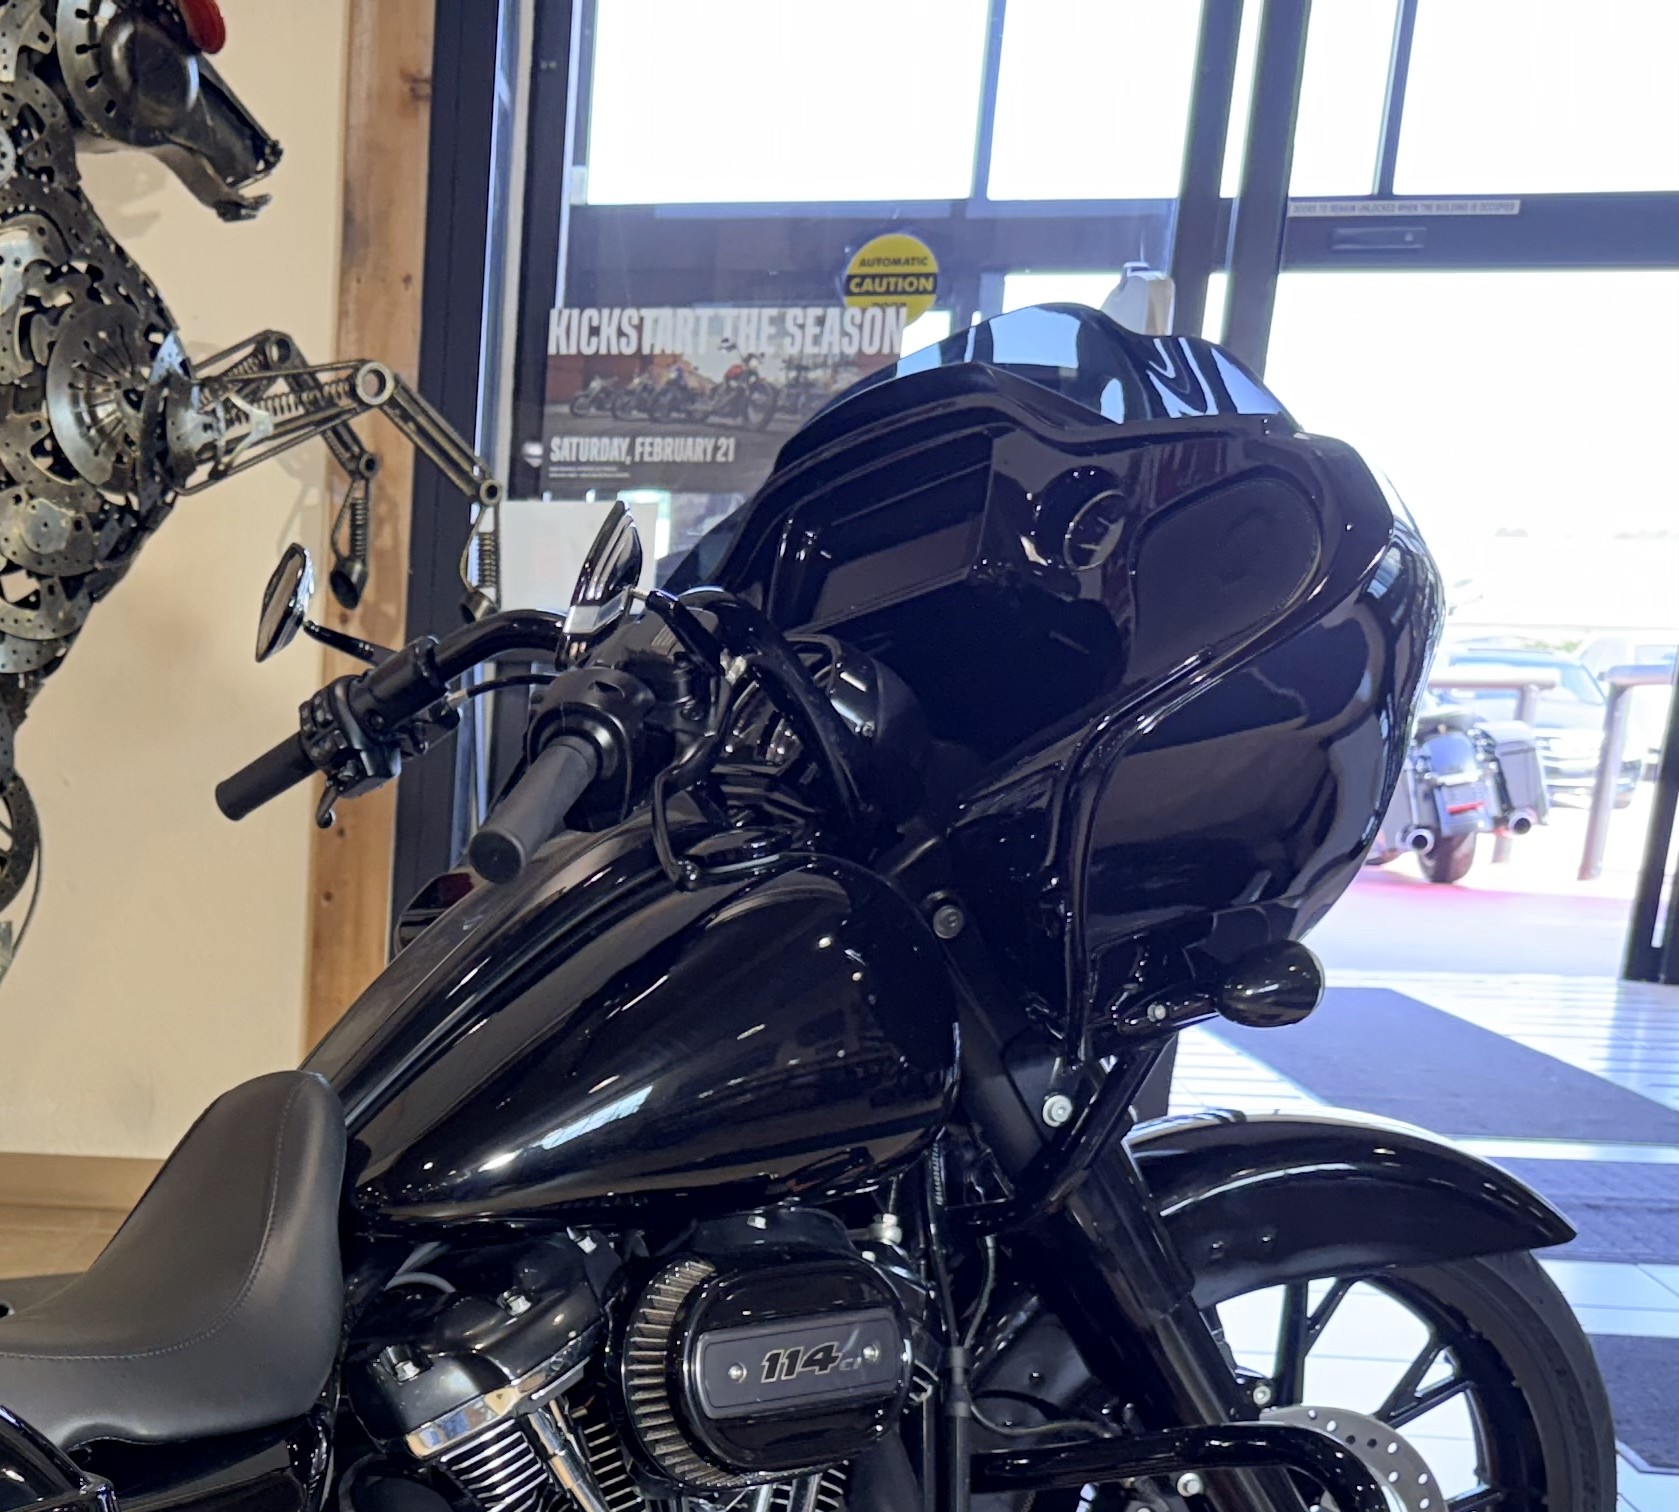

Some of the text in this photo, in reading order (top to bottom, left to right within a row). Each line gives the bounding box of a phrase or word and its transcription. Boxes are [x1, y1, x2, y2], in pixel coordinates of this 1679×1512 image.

[859, 257, 928, 267] AUTOMATIC
[849, 276, 934, 293] CAUTION
[549, 306, 908, 355] KICKSTART THE SEASON
[549, 436, 736, 465] SATURDAY, FEBRUARY 21
[760, 1341, 843, 1384] 114
